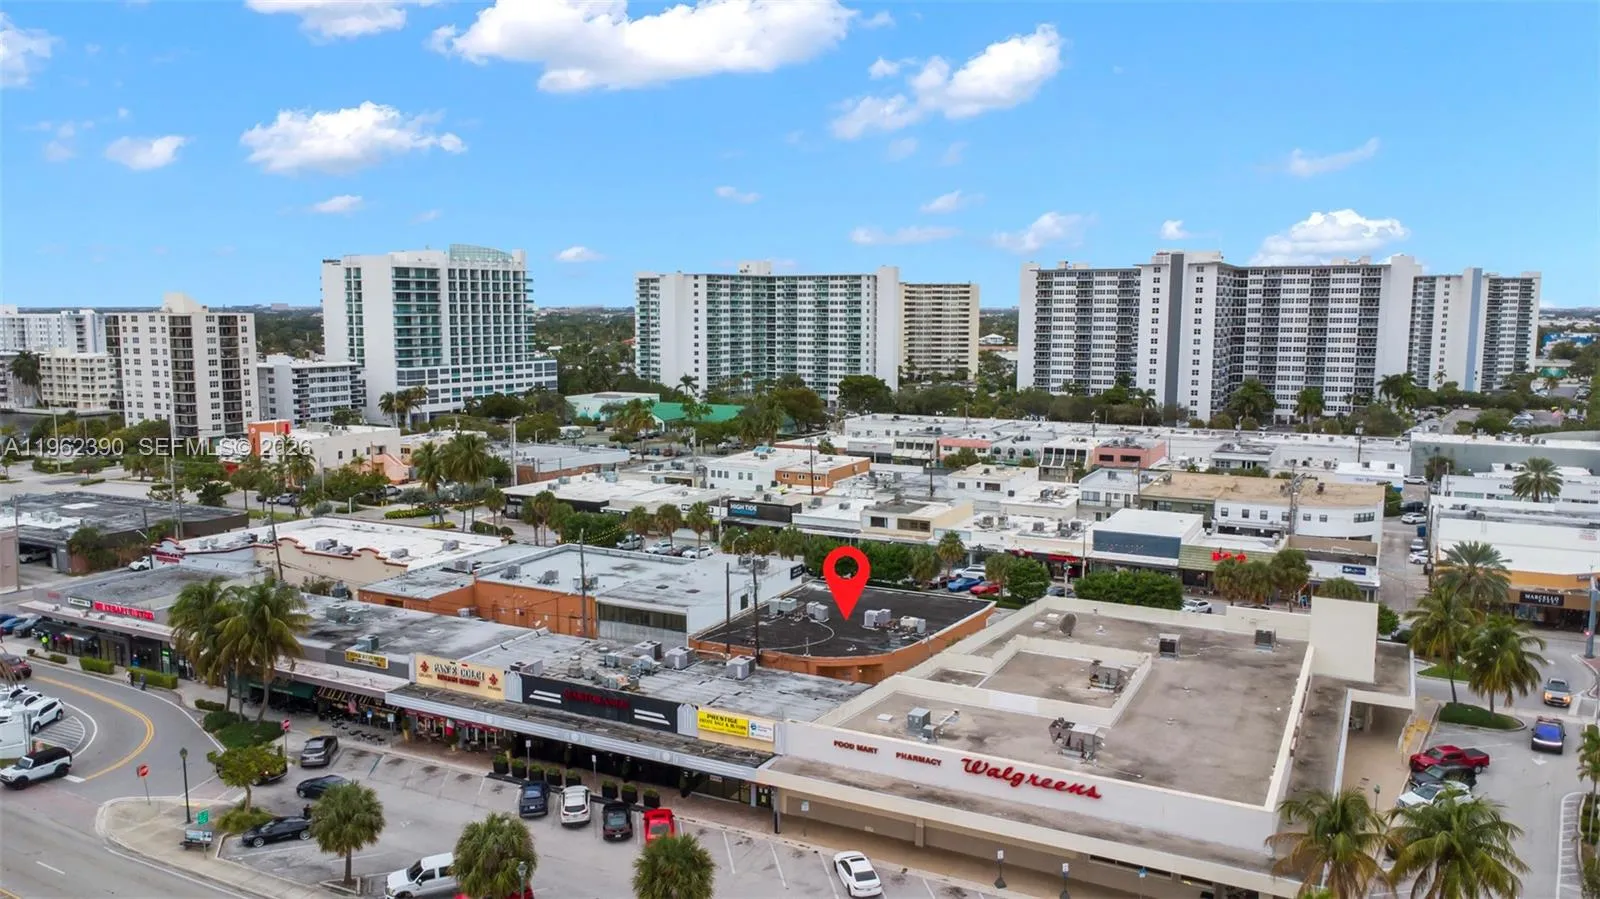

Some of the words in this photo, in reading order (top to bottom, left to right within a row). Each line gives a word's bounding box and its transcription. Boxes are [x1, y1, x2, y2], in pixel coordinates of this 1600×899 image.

[1524, 593, 1560, 601] MARCELLO
[706, 713, 737, 724] PRESTIGE
[833, 740, 855, 750] FOOD
[856, 744, 878, 754] MART
[896, 752, 942, 766] PHARMACY
[961, 758, 1102, 799] Walgreens
